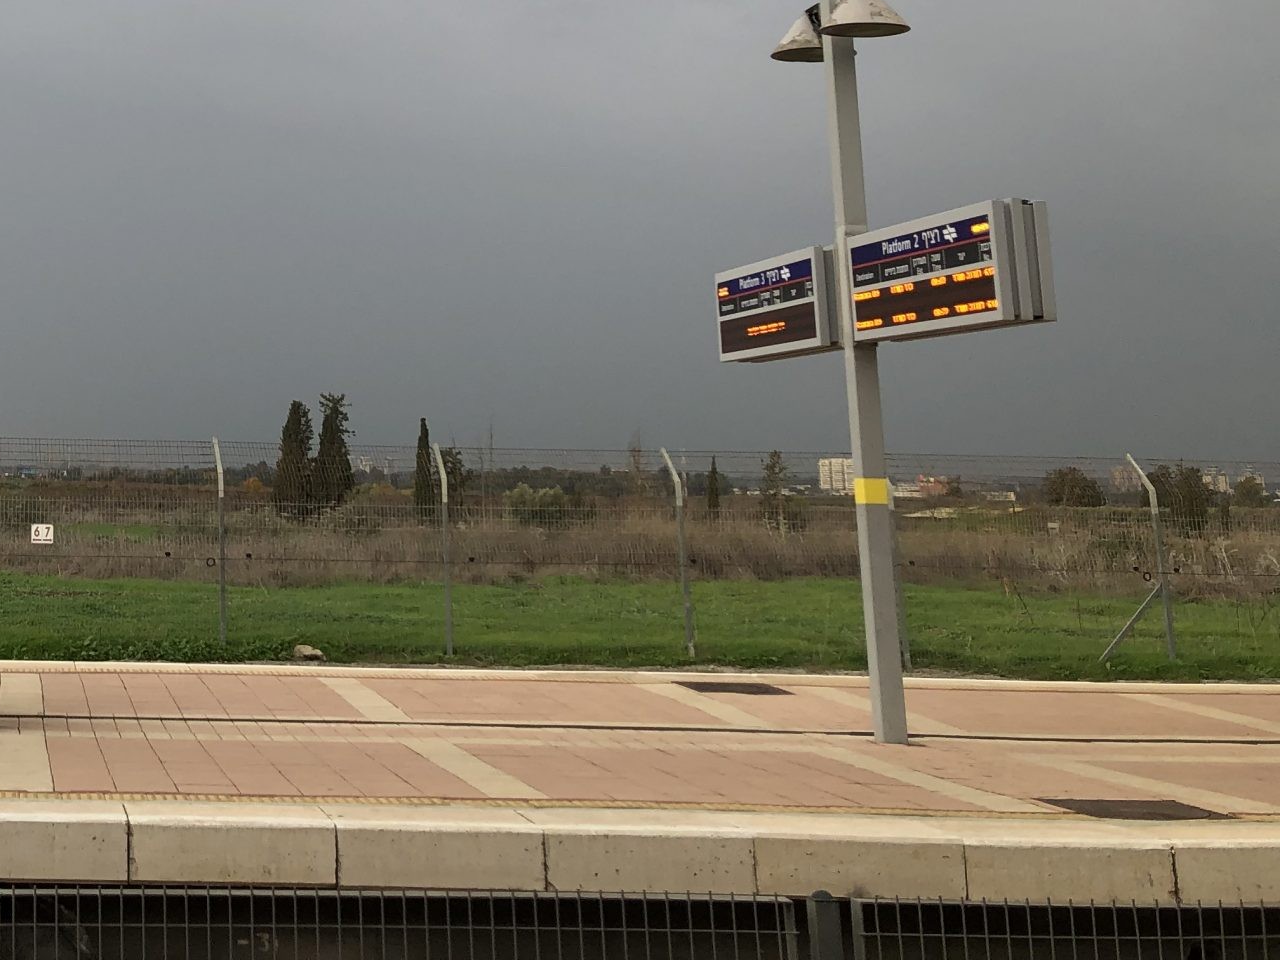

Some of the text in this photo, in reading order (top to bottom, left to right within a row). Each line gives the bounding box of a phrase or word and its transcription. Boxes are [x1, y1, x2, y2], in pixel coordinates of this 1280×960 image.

[881, 229, 940, 255] Platform 2 רציף
[760, 273, 766, 285] 3
[33, 526, 51, 538] 67
